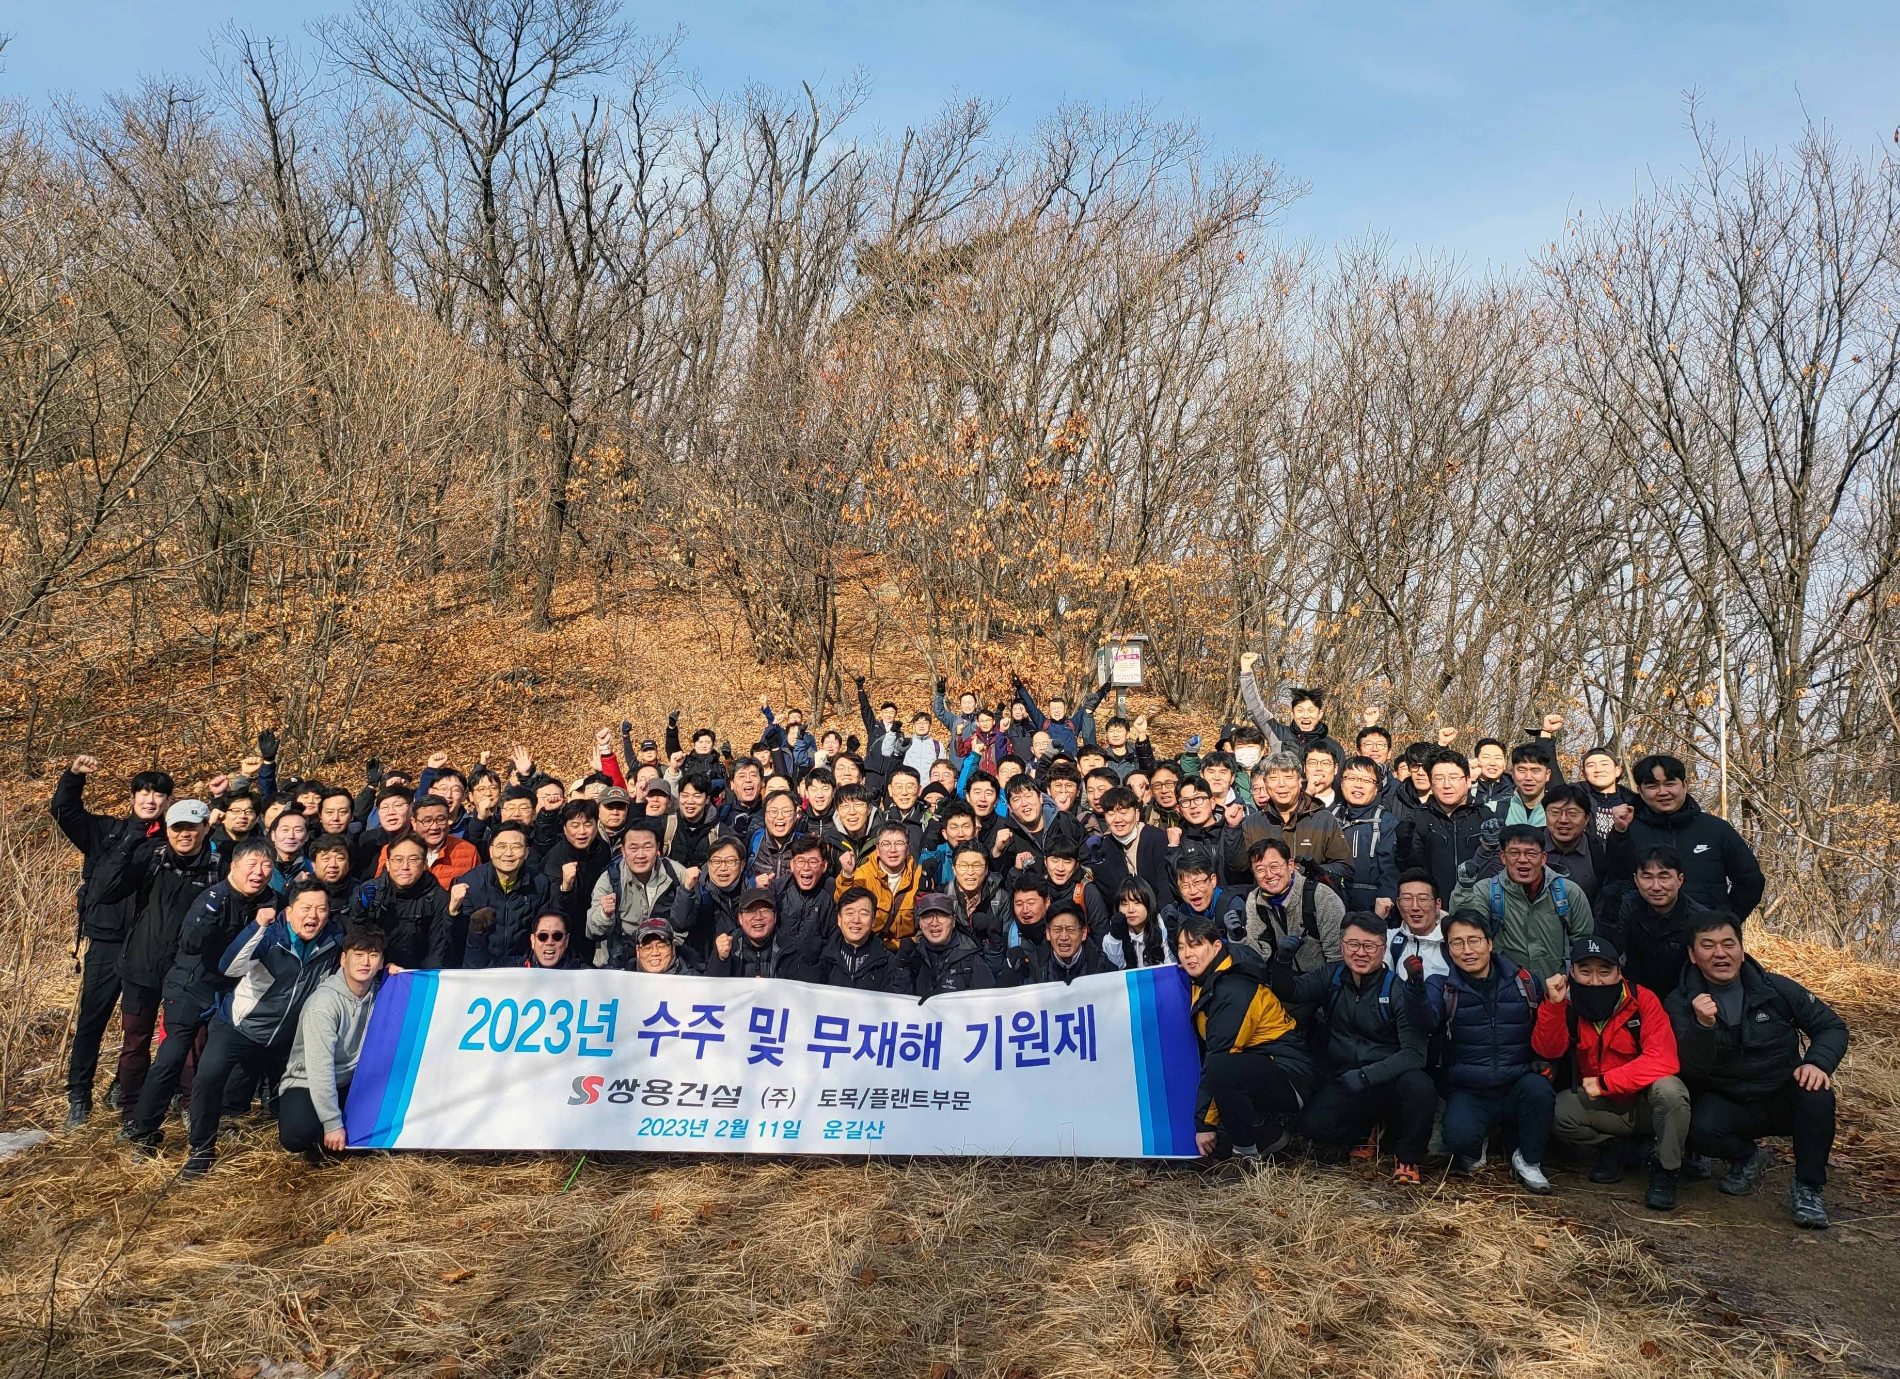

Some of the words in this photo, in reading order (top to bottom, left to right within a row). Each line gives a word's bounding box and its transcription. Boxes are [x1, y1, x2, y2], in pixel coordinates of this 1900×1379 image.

[1587, 939, 1601, 953] LA
[459, 997, 619, 1057] 2023년
[638, 1001, 726, 1059] 수주
[747, 1007, 789, 1067] 및
[807, 1015, 942, 1070] 무재해
[964, 1004, 1097, 1070] 기원제
[607, 1079, 742, 1108] 쌍용건설
[761, 1087, 795, 1109] (주)
[818, 1088, 971, 1110] 토목/플랜트부문
[637, 1118, 708, 1137] 2023년
[715, 1119, 749, 1138] 2월
[759, 1120, 801, 1139] 11일
[824, 1120, 885, 1139] 운길산
